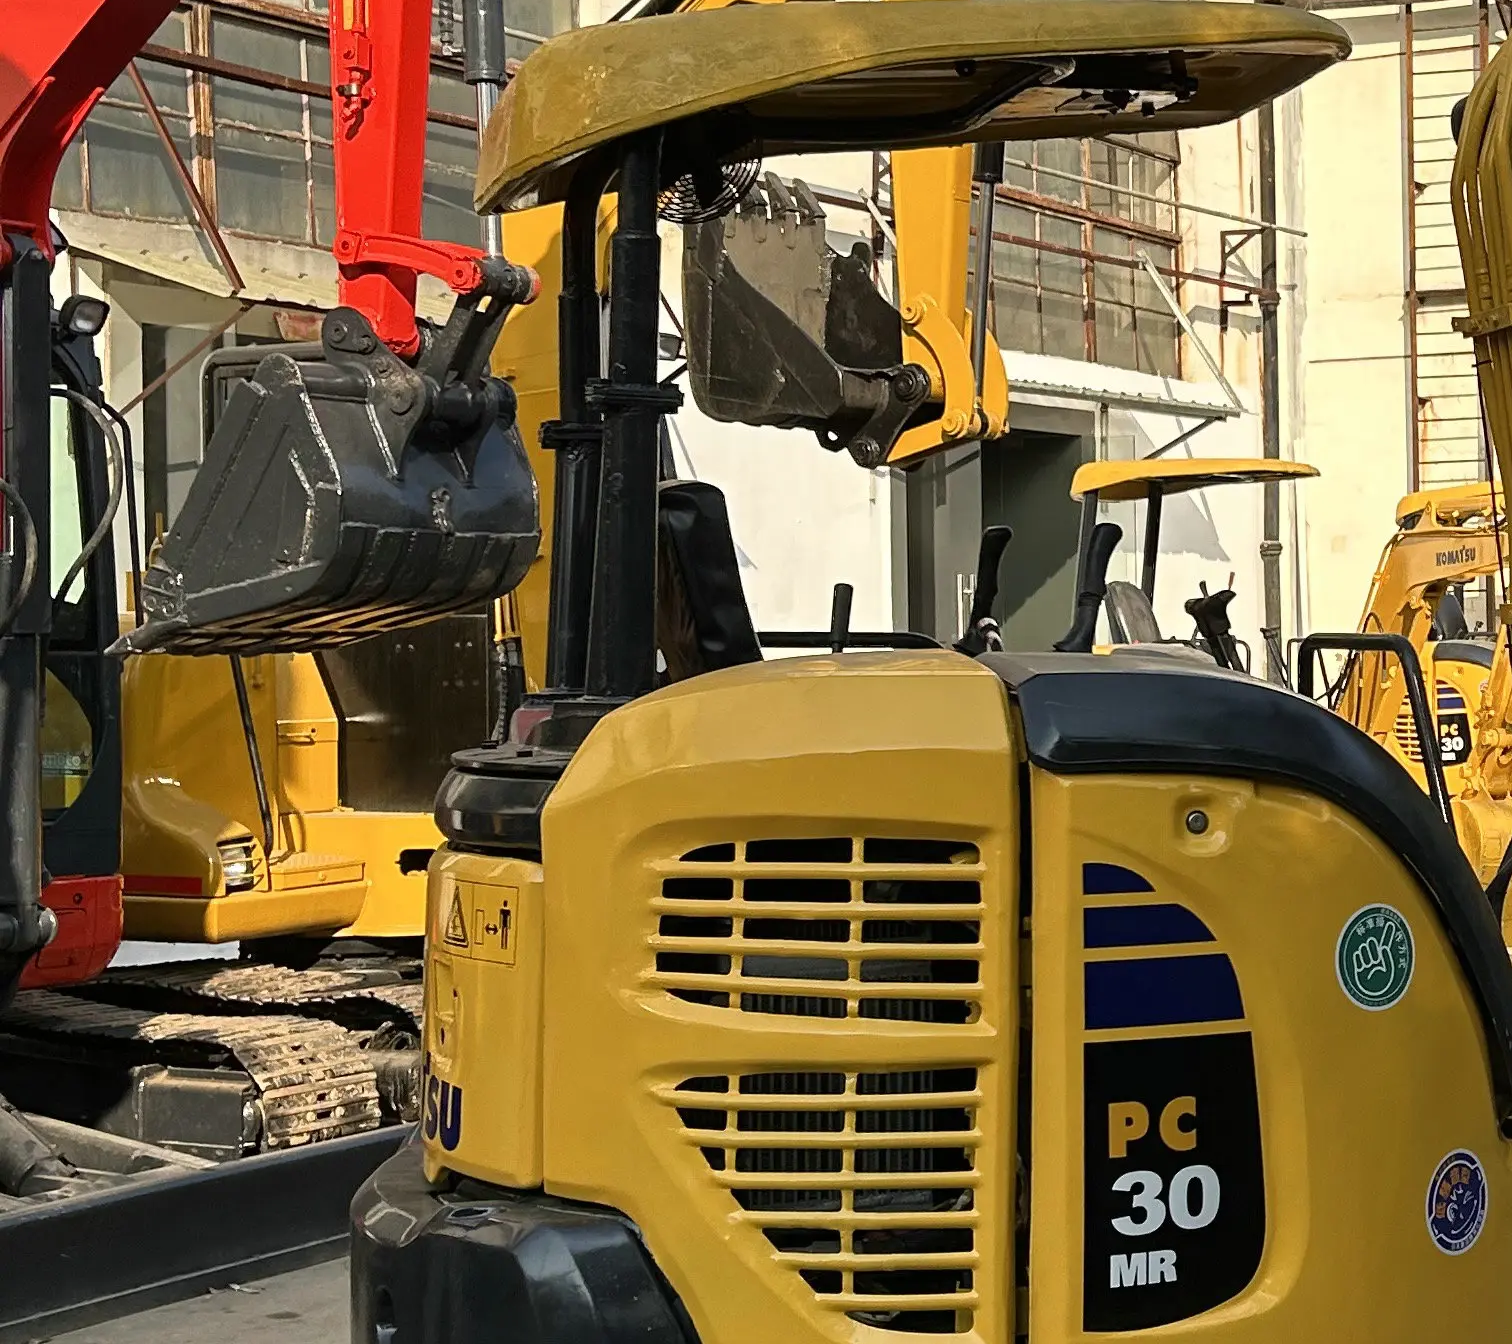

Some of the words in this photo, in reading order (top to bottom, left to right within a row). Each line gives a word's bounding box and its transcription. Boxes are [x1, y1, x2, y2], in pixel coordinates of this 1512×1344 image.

[1436, 545, 1476, 566] KOMATSU
[1440, 723, 1460, 737] PC
[1440, 736, 1465, 752] 30
[1108, 1096, 1198, 1159] PC
[1111, 1164, 1221, 1236] 30
[1109, 1249, 1178, 1289] MR
